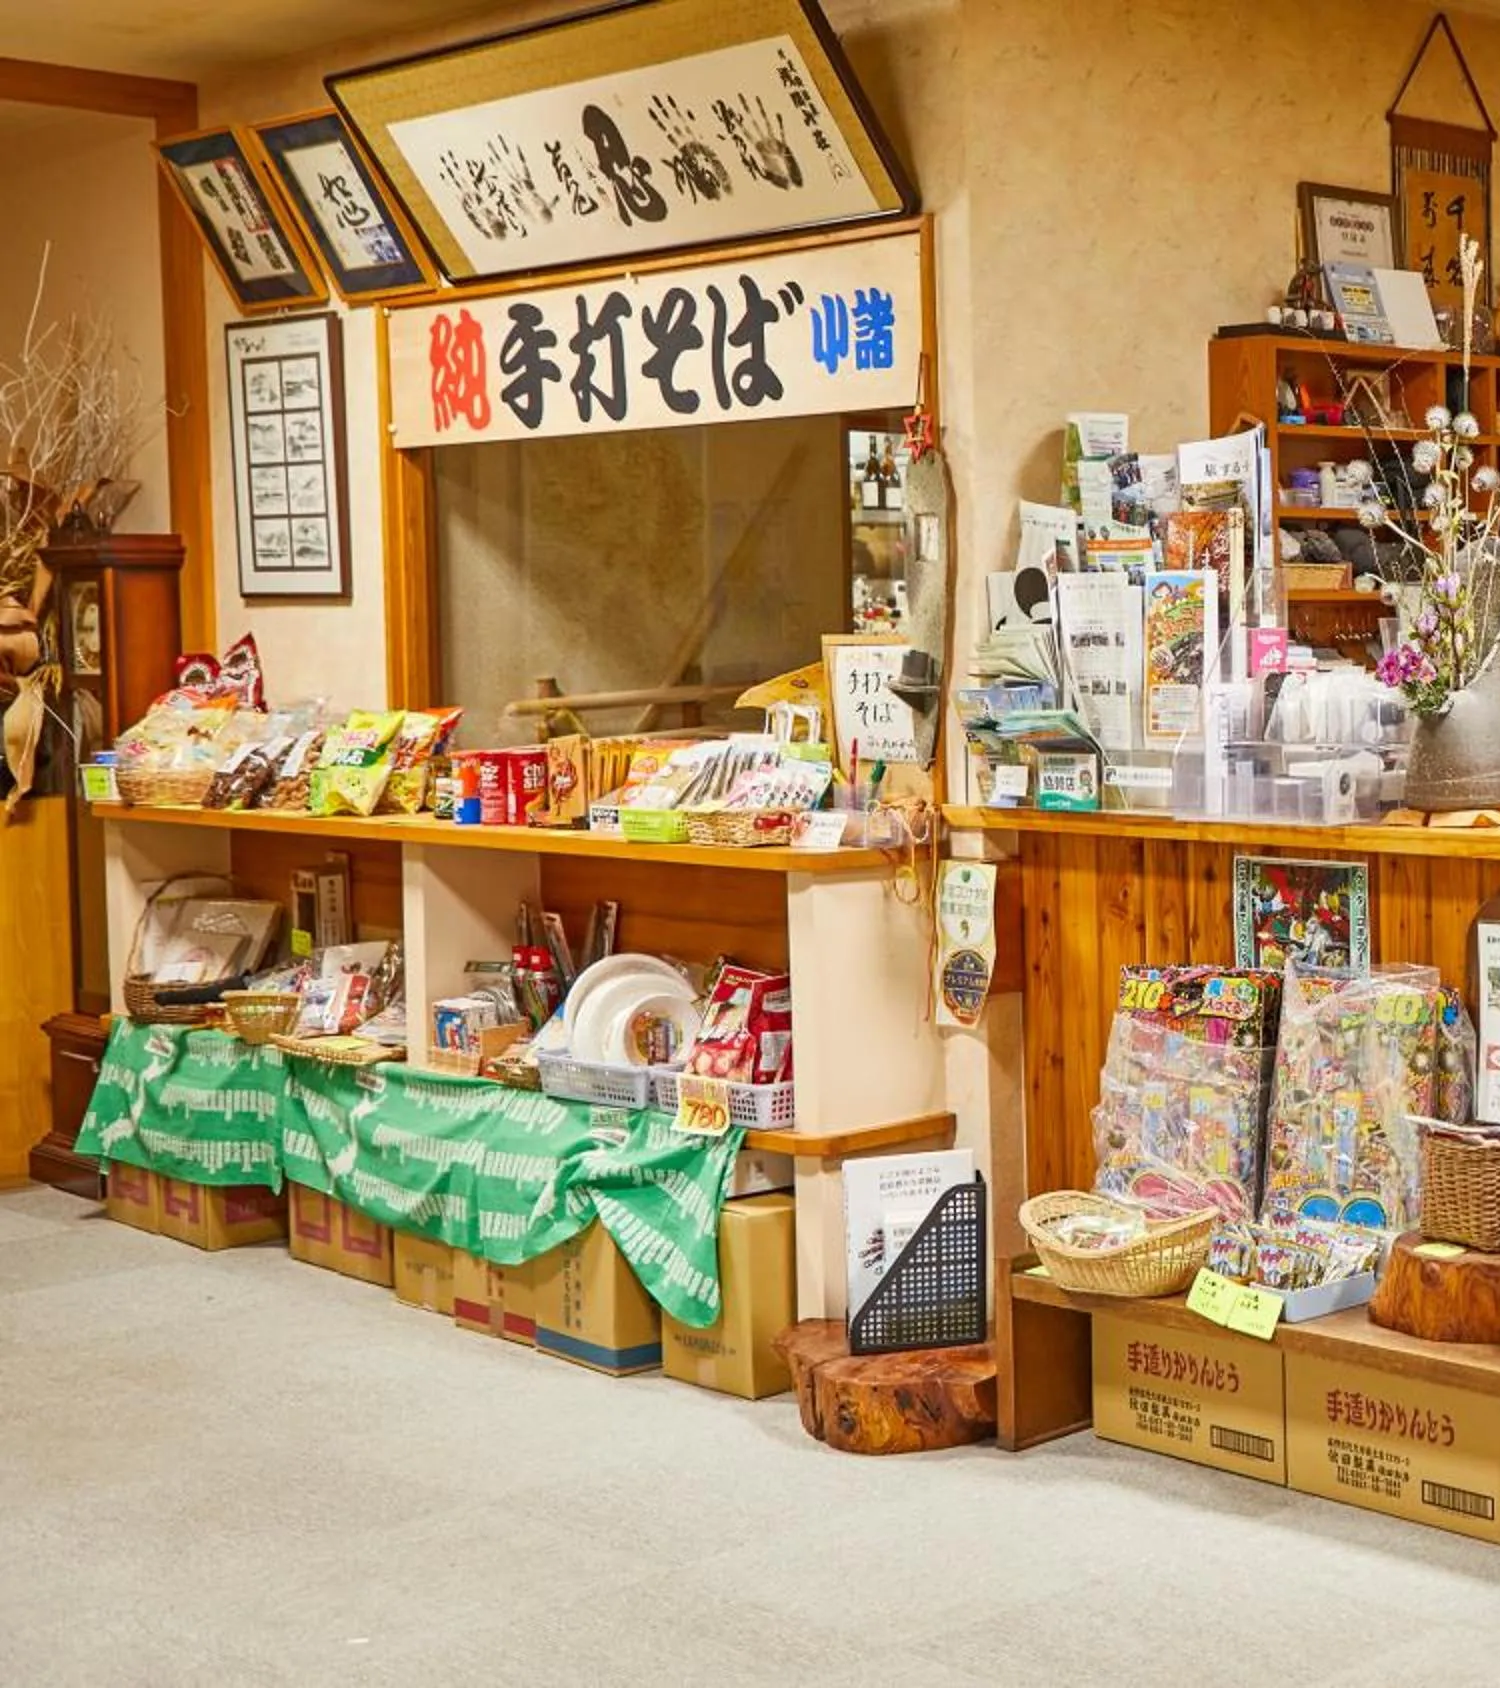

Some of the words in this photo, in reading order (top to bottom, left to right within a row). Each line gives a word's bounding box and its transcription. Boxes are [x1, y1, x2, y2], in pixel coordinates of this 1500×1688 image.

[856, 702, 898, 727] そば
[685, 1099, 728, 1134] 780
[1127, 1341, 1239, 1393] 手造りかりんとう
[1327, 1389, 1455, 1446] 手造りかりんとう
